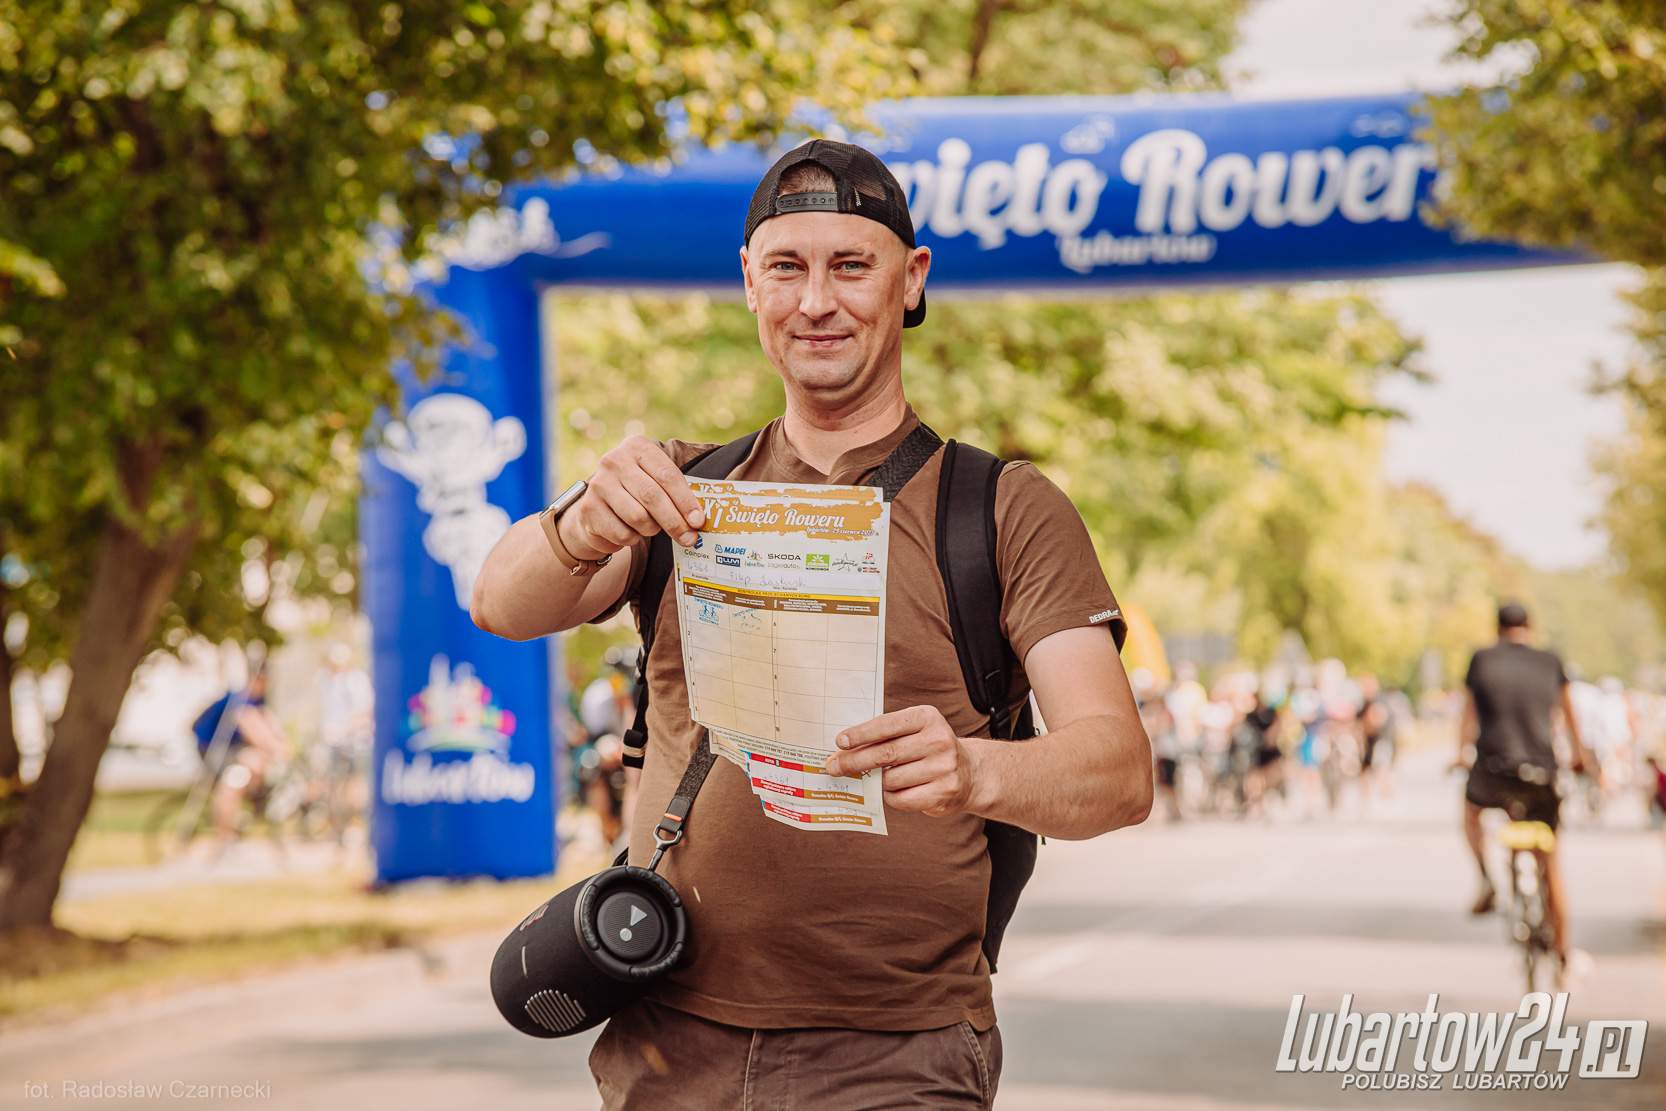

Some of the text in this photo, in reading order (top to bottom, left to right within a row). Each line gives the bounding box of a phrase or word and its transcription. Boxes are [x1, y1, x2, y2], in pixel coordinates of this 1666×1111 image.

[1121, 129, 1438, 236] Rower
[726, 506, 779, 527] Święto
[784, 508, 845, 527] Roweru
[724, 546, 746, 555] MAPEI
